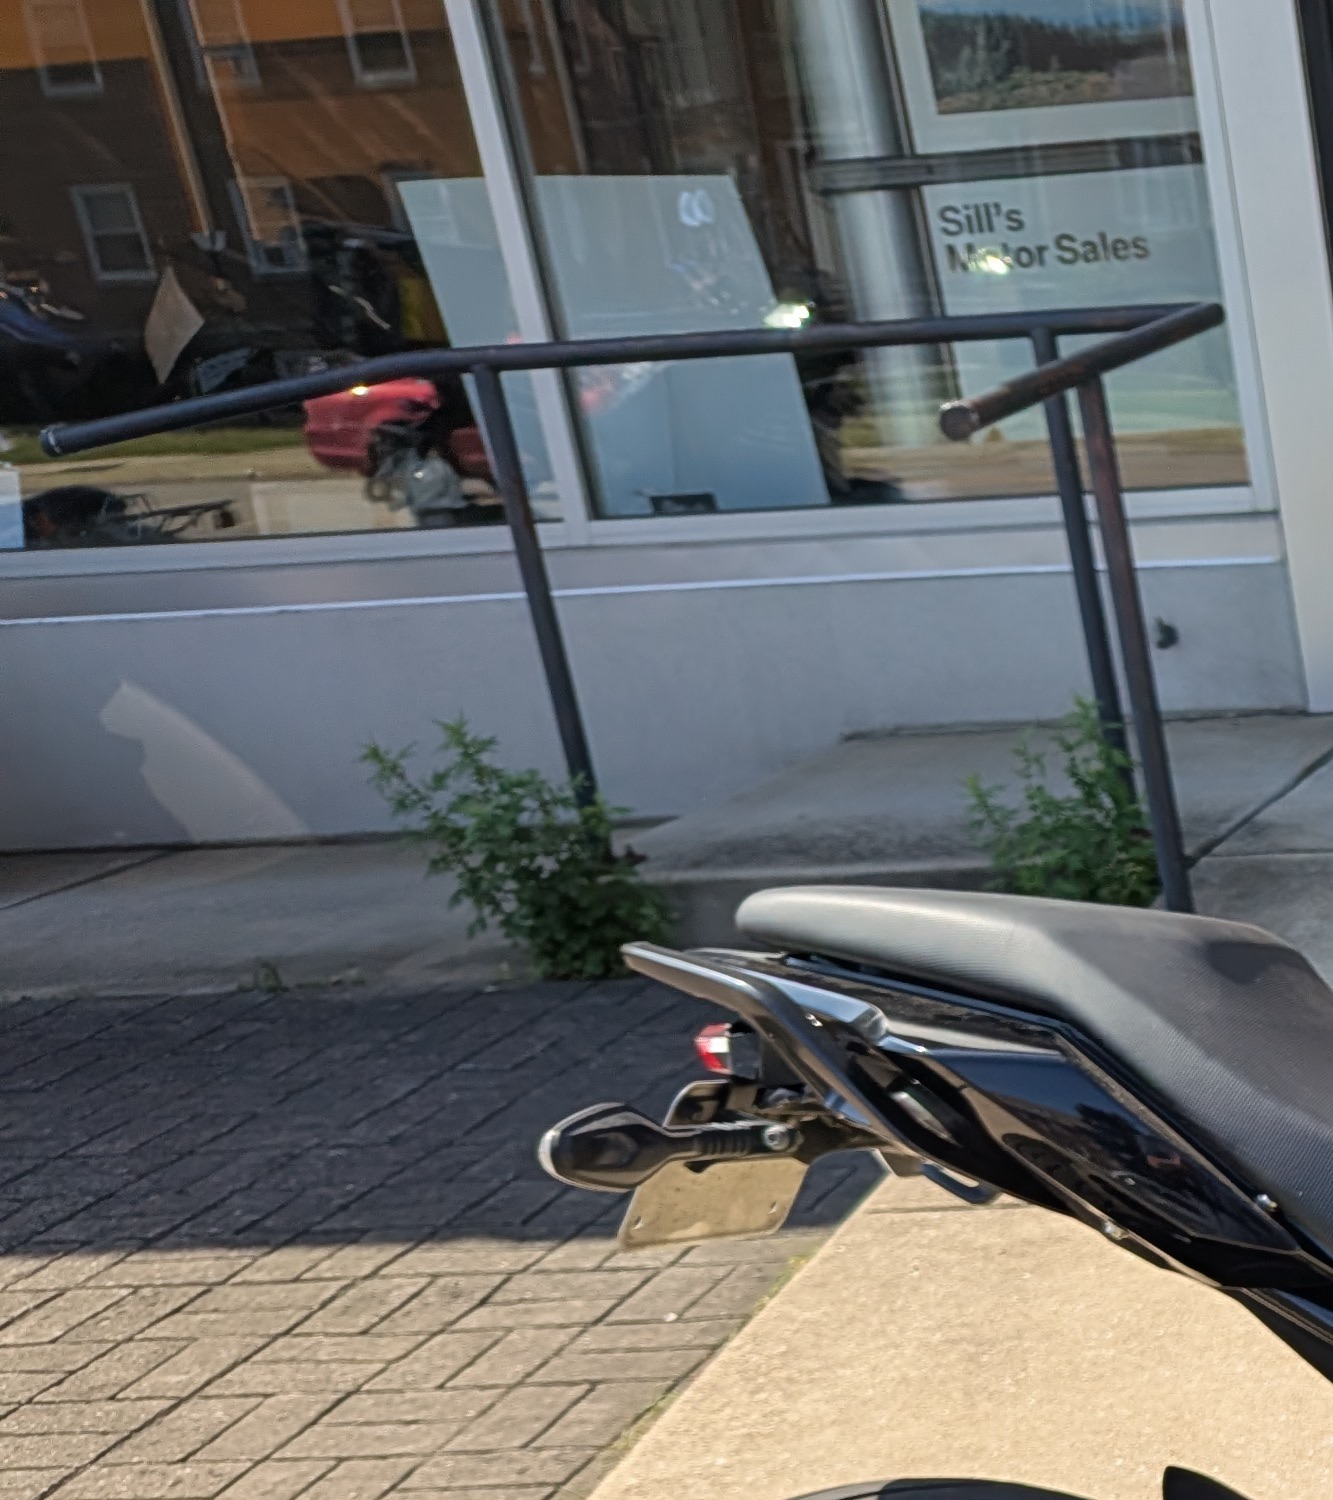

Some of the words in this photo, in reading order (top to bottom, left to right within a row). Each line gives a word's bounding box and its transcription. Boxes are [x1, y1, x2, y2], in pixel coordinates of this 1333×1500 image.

[938, 202, 1025, 237] Sill's
[945, 242, 1050, 273] Mtor
[1055, 231, 1150, 265] Sales
